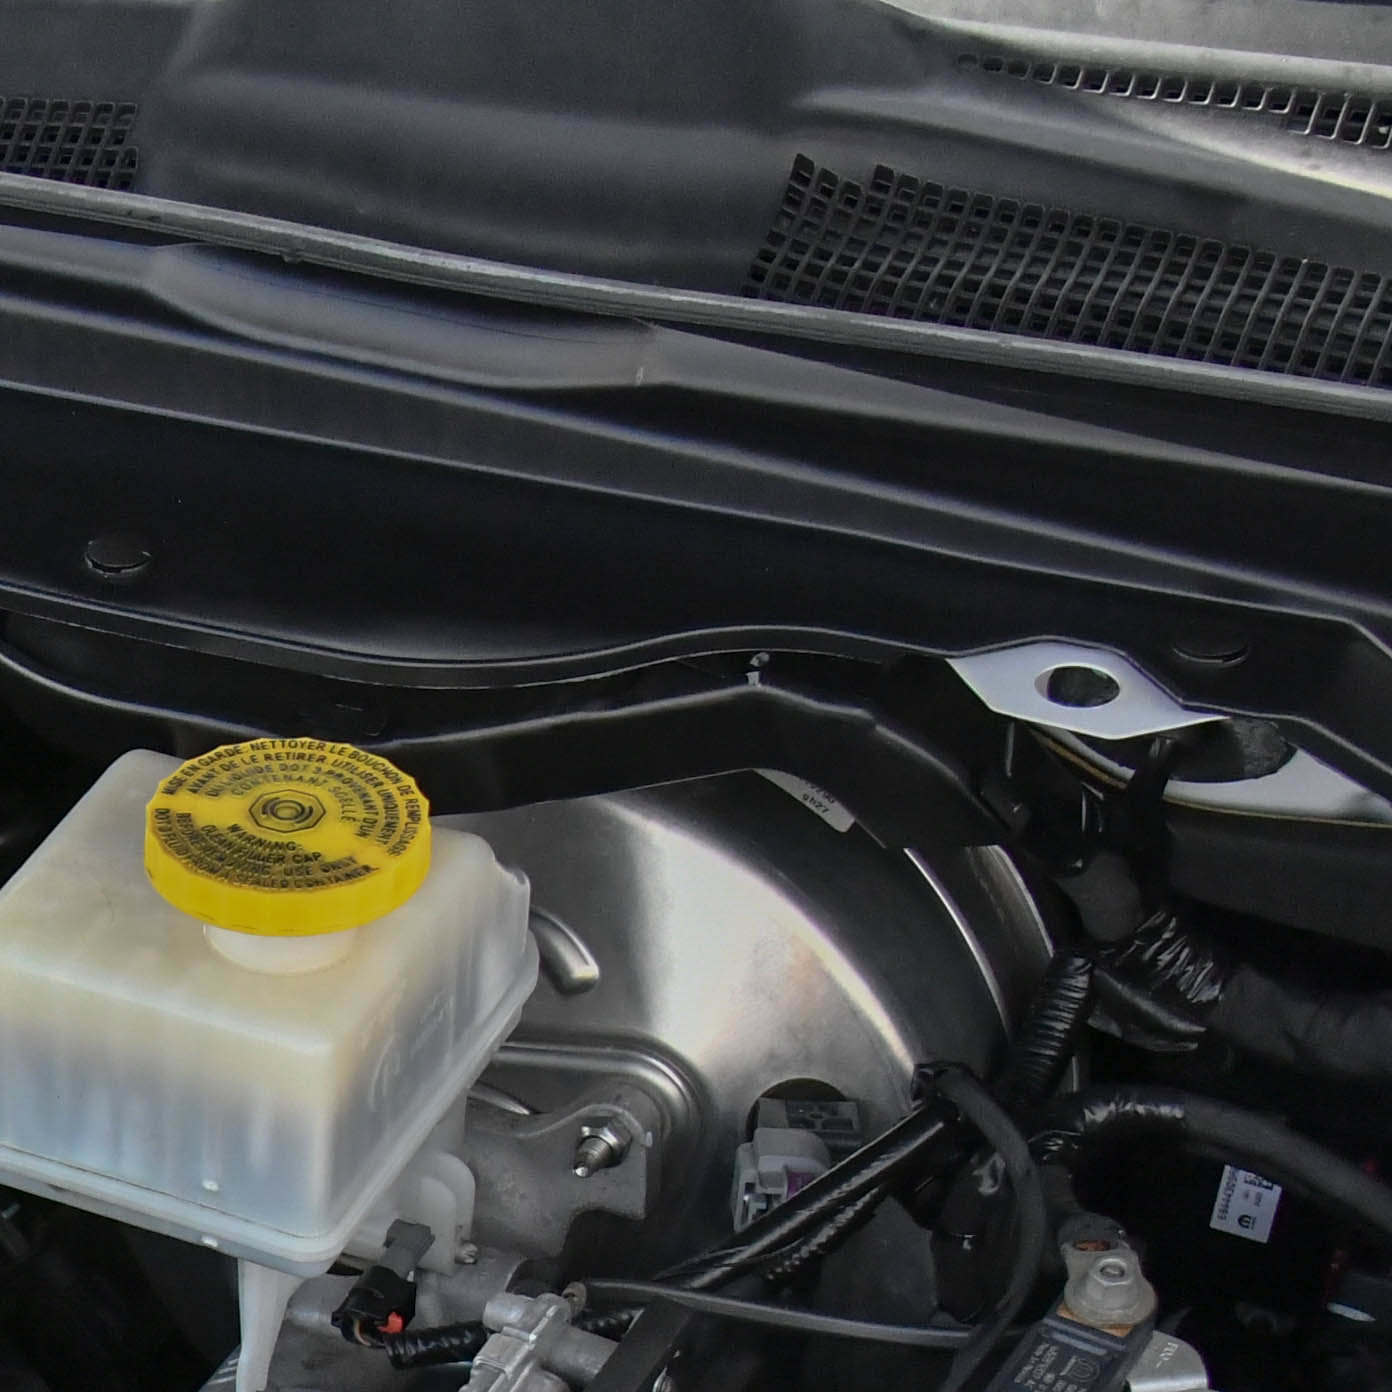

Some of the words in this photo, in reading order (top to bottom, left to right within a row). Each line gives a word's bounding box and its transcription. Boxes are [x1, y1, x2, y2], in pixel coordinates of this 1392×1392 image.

[240, 754, 259, 765] LE
[250, 739, 326, 751] NETTOYER
[329, 745, 348, 756] LE
[348, 750, 404, 785] BOUCHON
